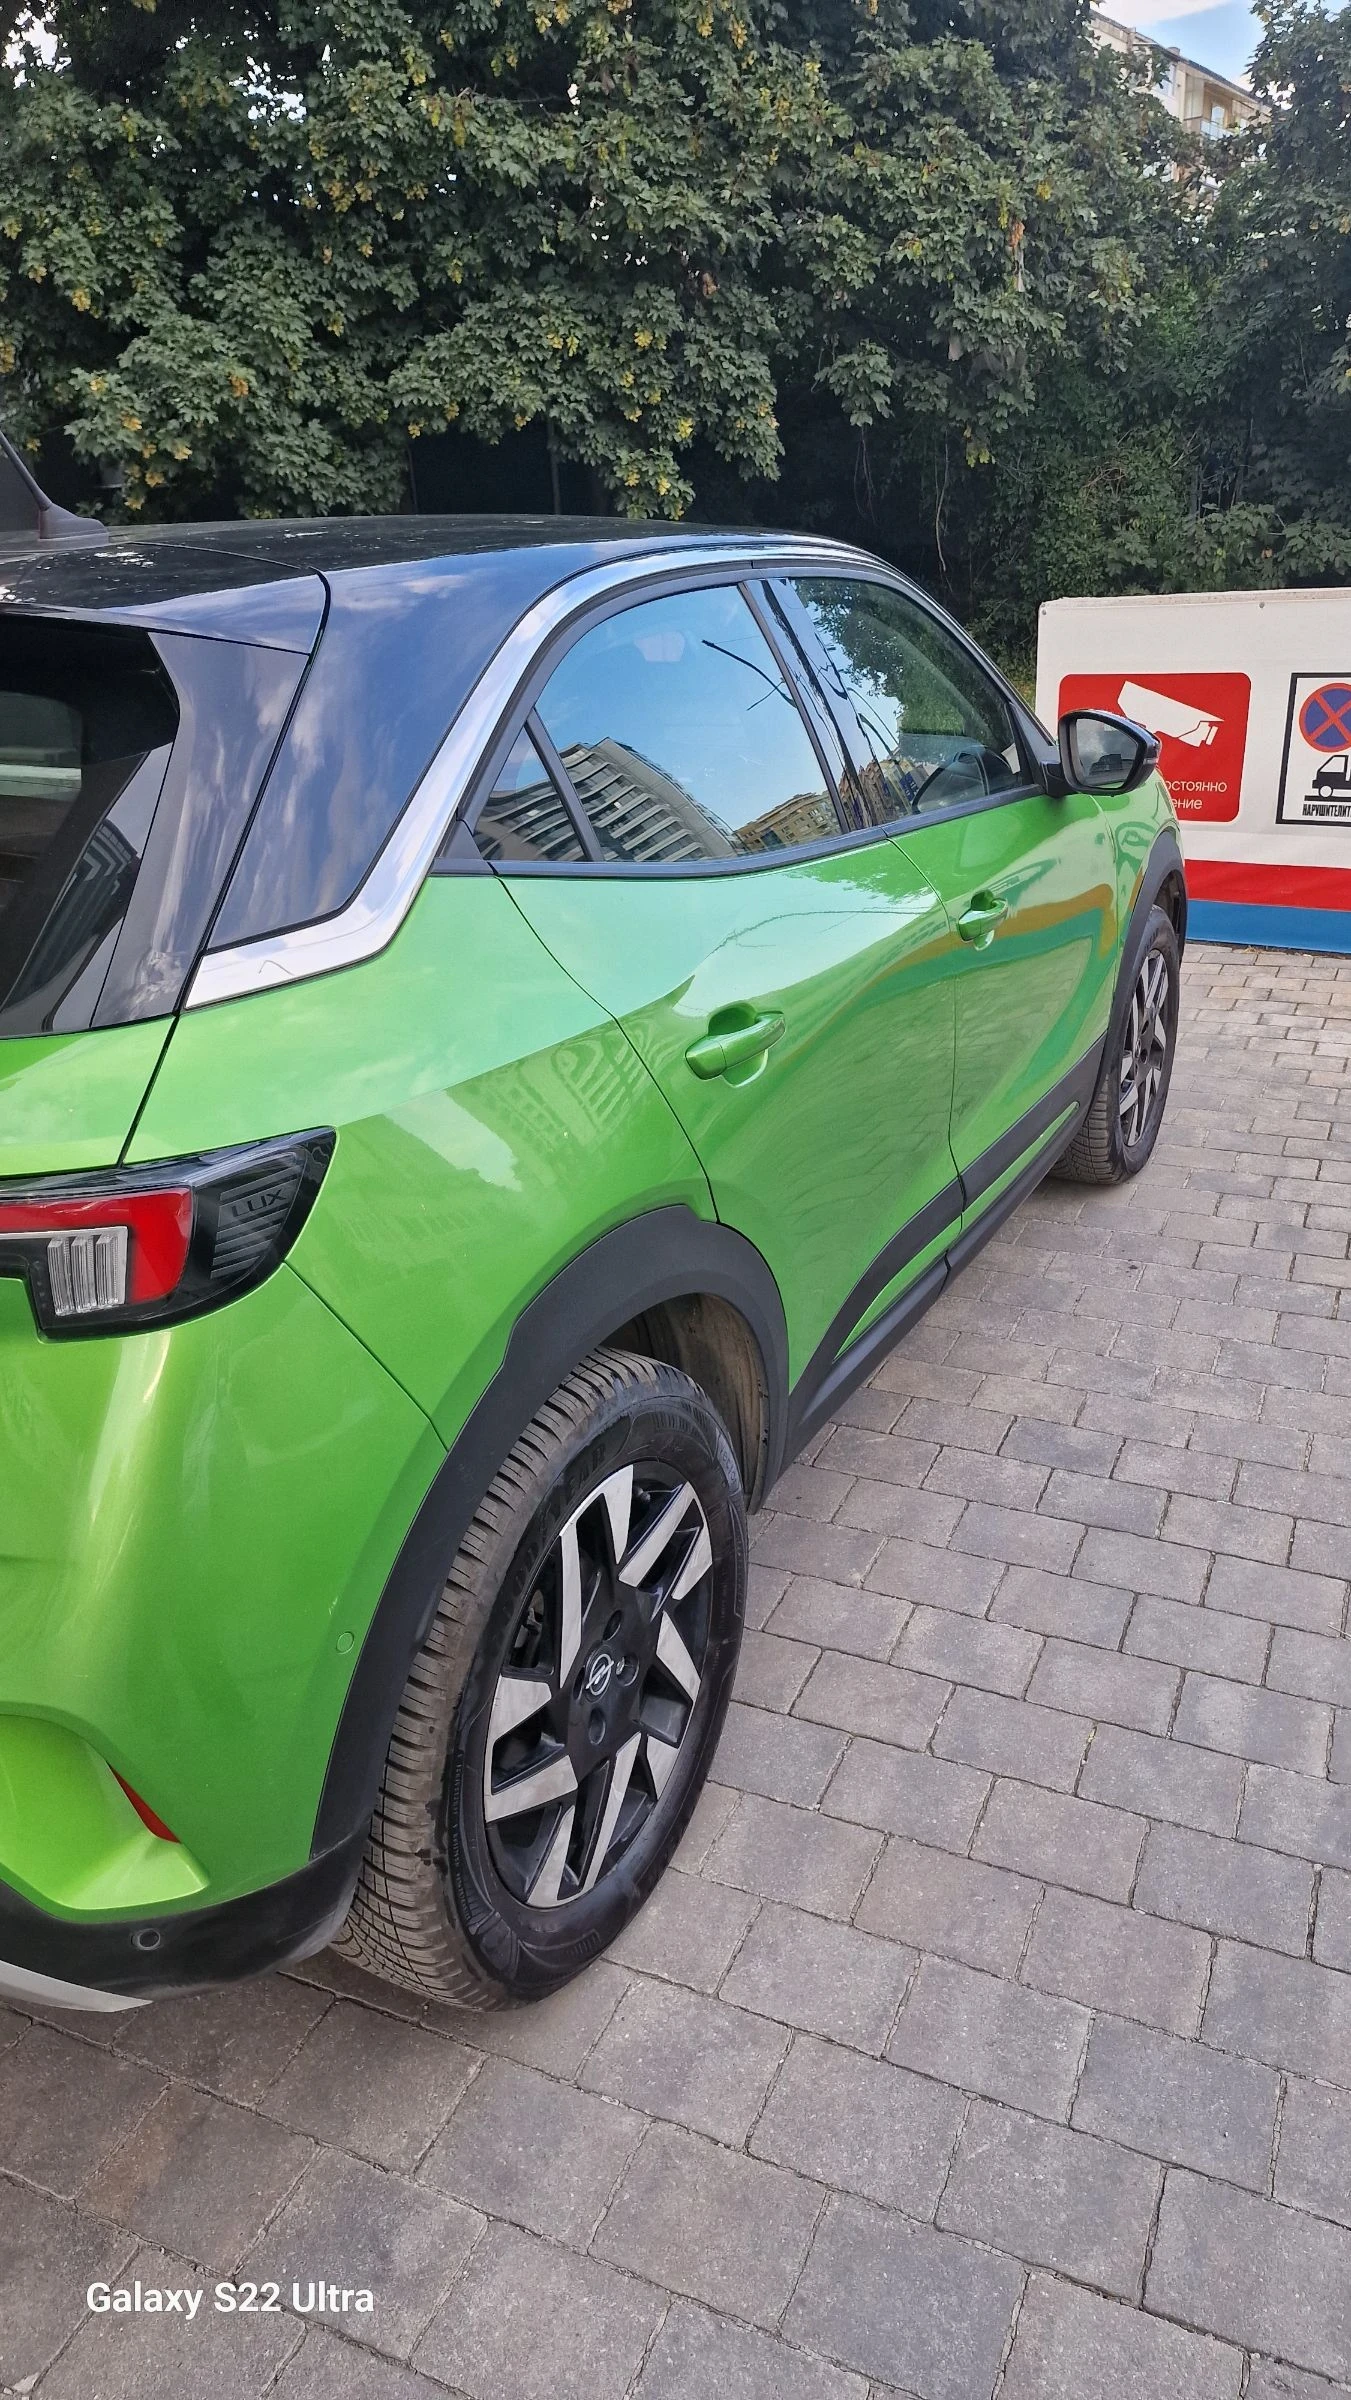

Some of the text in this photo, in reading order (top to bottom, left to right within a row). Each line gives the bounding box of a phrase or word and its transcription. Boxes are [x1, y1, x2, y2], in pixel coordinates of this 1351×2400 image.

[1165, 781, 1227, 792] остоянно
[1172, 799, 1202, 809] ение
[1302, 803, 1351, 817] НАРУШИТЕЛИТ
[232, 1189, 287, 1216] LUX
